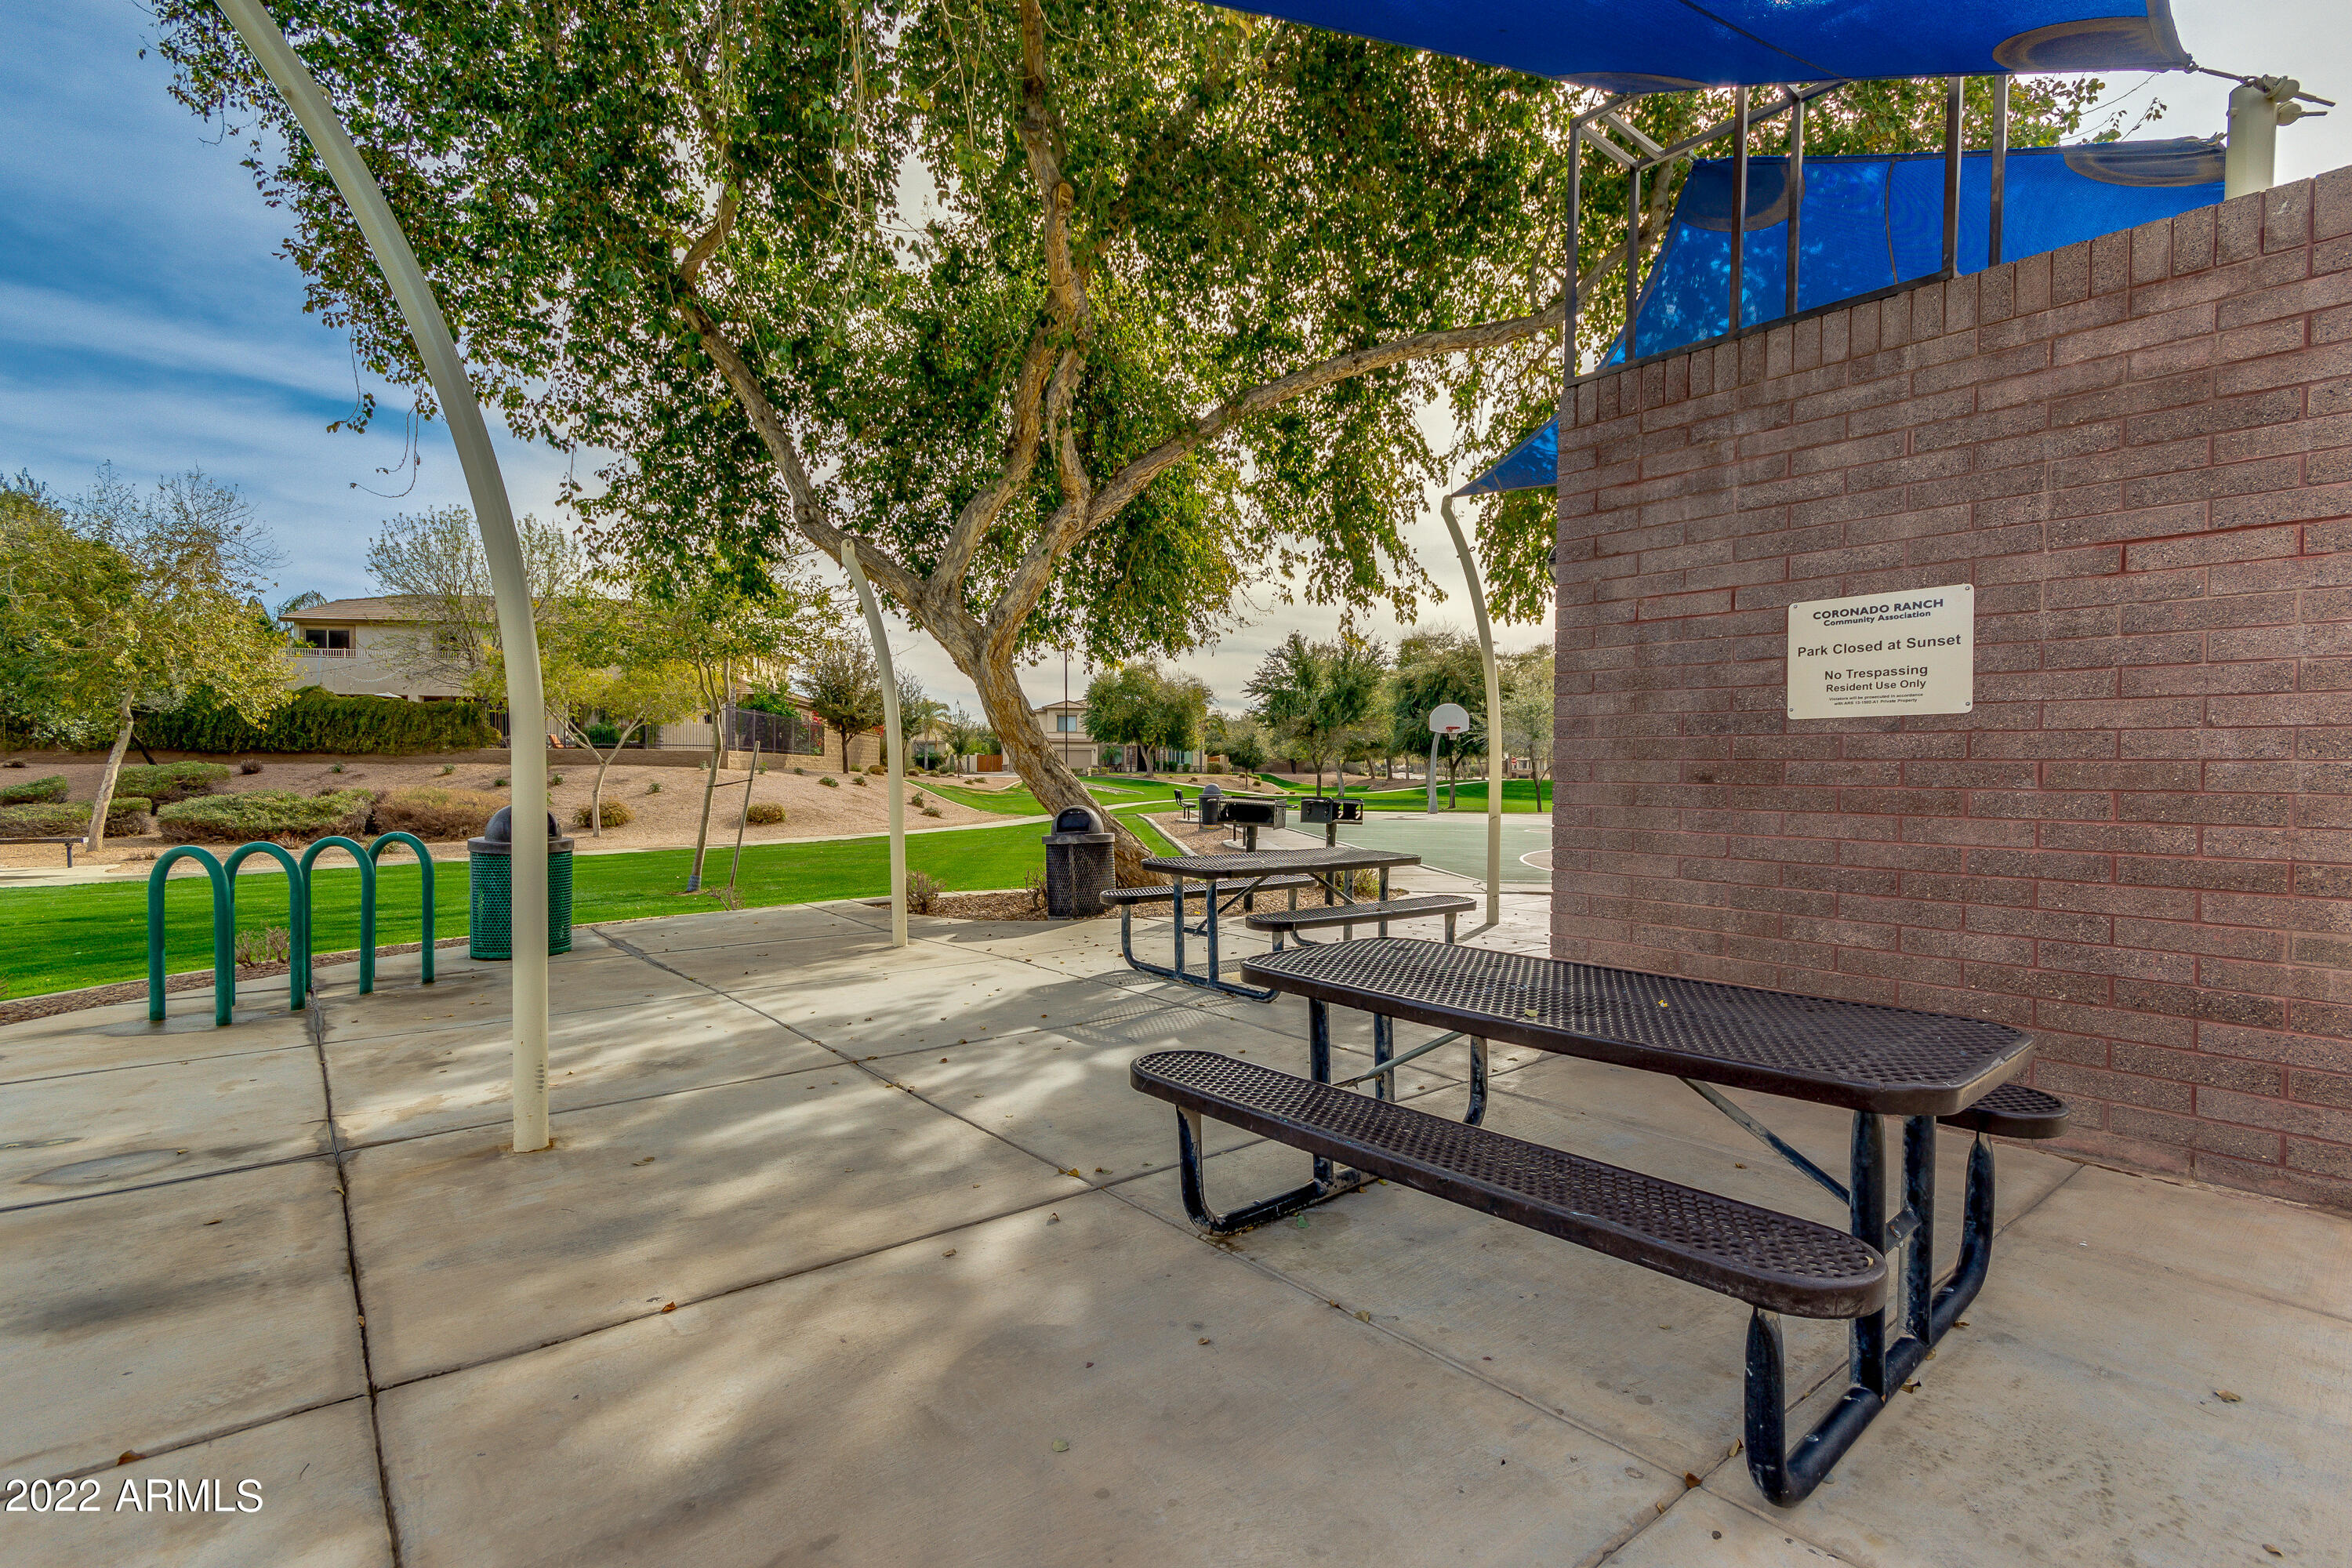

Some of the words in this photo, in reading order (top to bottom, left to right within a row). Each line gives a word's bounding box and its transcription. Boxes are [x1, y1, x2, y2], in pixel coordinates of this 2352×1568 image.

[1813, 604, 1889, 620] CORONADO
[1893, 598, 1944, 612] RANCH
[1823, 616, 1875, 626] Community
[1877, 610, 1931, 622] Association
[1798, 645, 1828, 657] Park
[1832, 640, 1882, 655] Closed
[1887, 639, 1901, 650] at
[1906, 633, 1962, 648] Sunset
[1824, 670, 1842, 681] No
[1846, 665, 1928, 679] Trespassing
[1826, 682, 1873, 692] Resident
[1875, 681, 1896, 690] Use
[1900, 679, 1926, 689] Only
